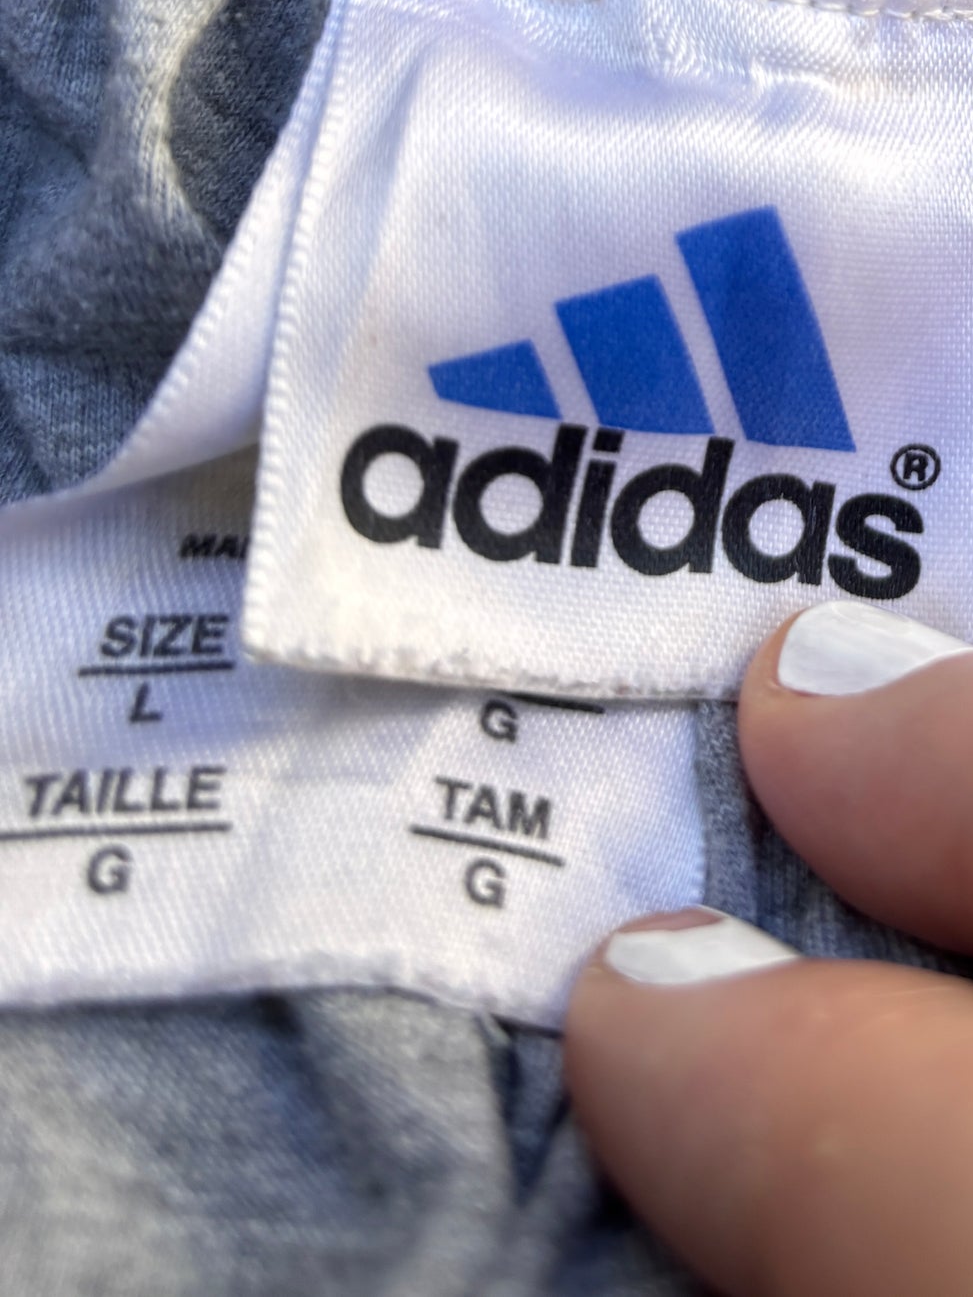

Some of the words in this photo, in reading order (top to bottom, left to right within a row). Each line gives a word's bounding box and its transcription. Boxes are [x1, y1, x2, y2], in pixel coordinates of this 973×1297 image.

[341, 423, 924, 600] adidas
[100, 614, 229, 657] SIZE
[128, 683, 163, 724] L
[479, 701, 518, 743] G
[24, 766, 227, 819] TAILLE
[435, 775, 552, 839] TAM
[87, 845, 132, 894] G
[464, 857, 508, 908] G
